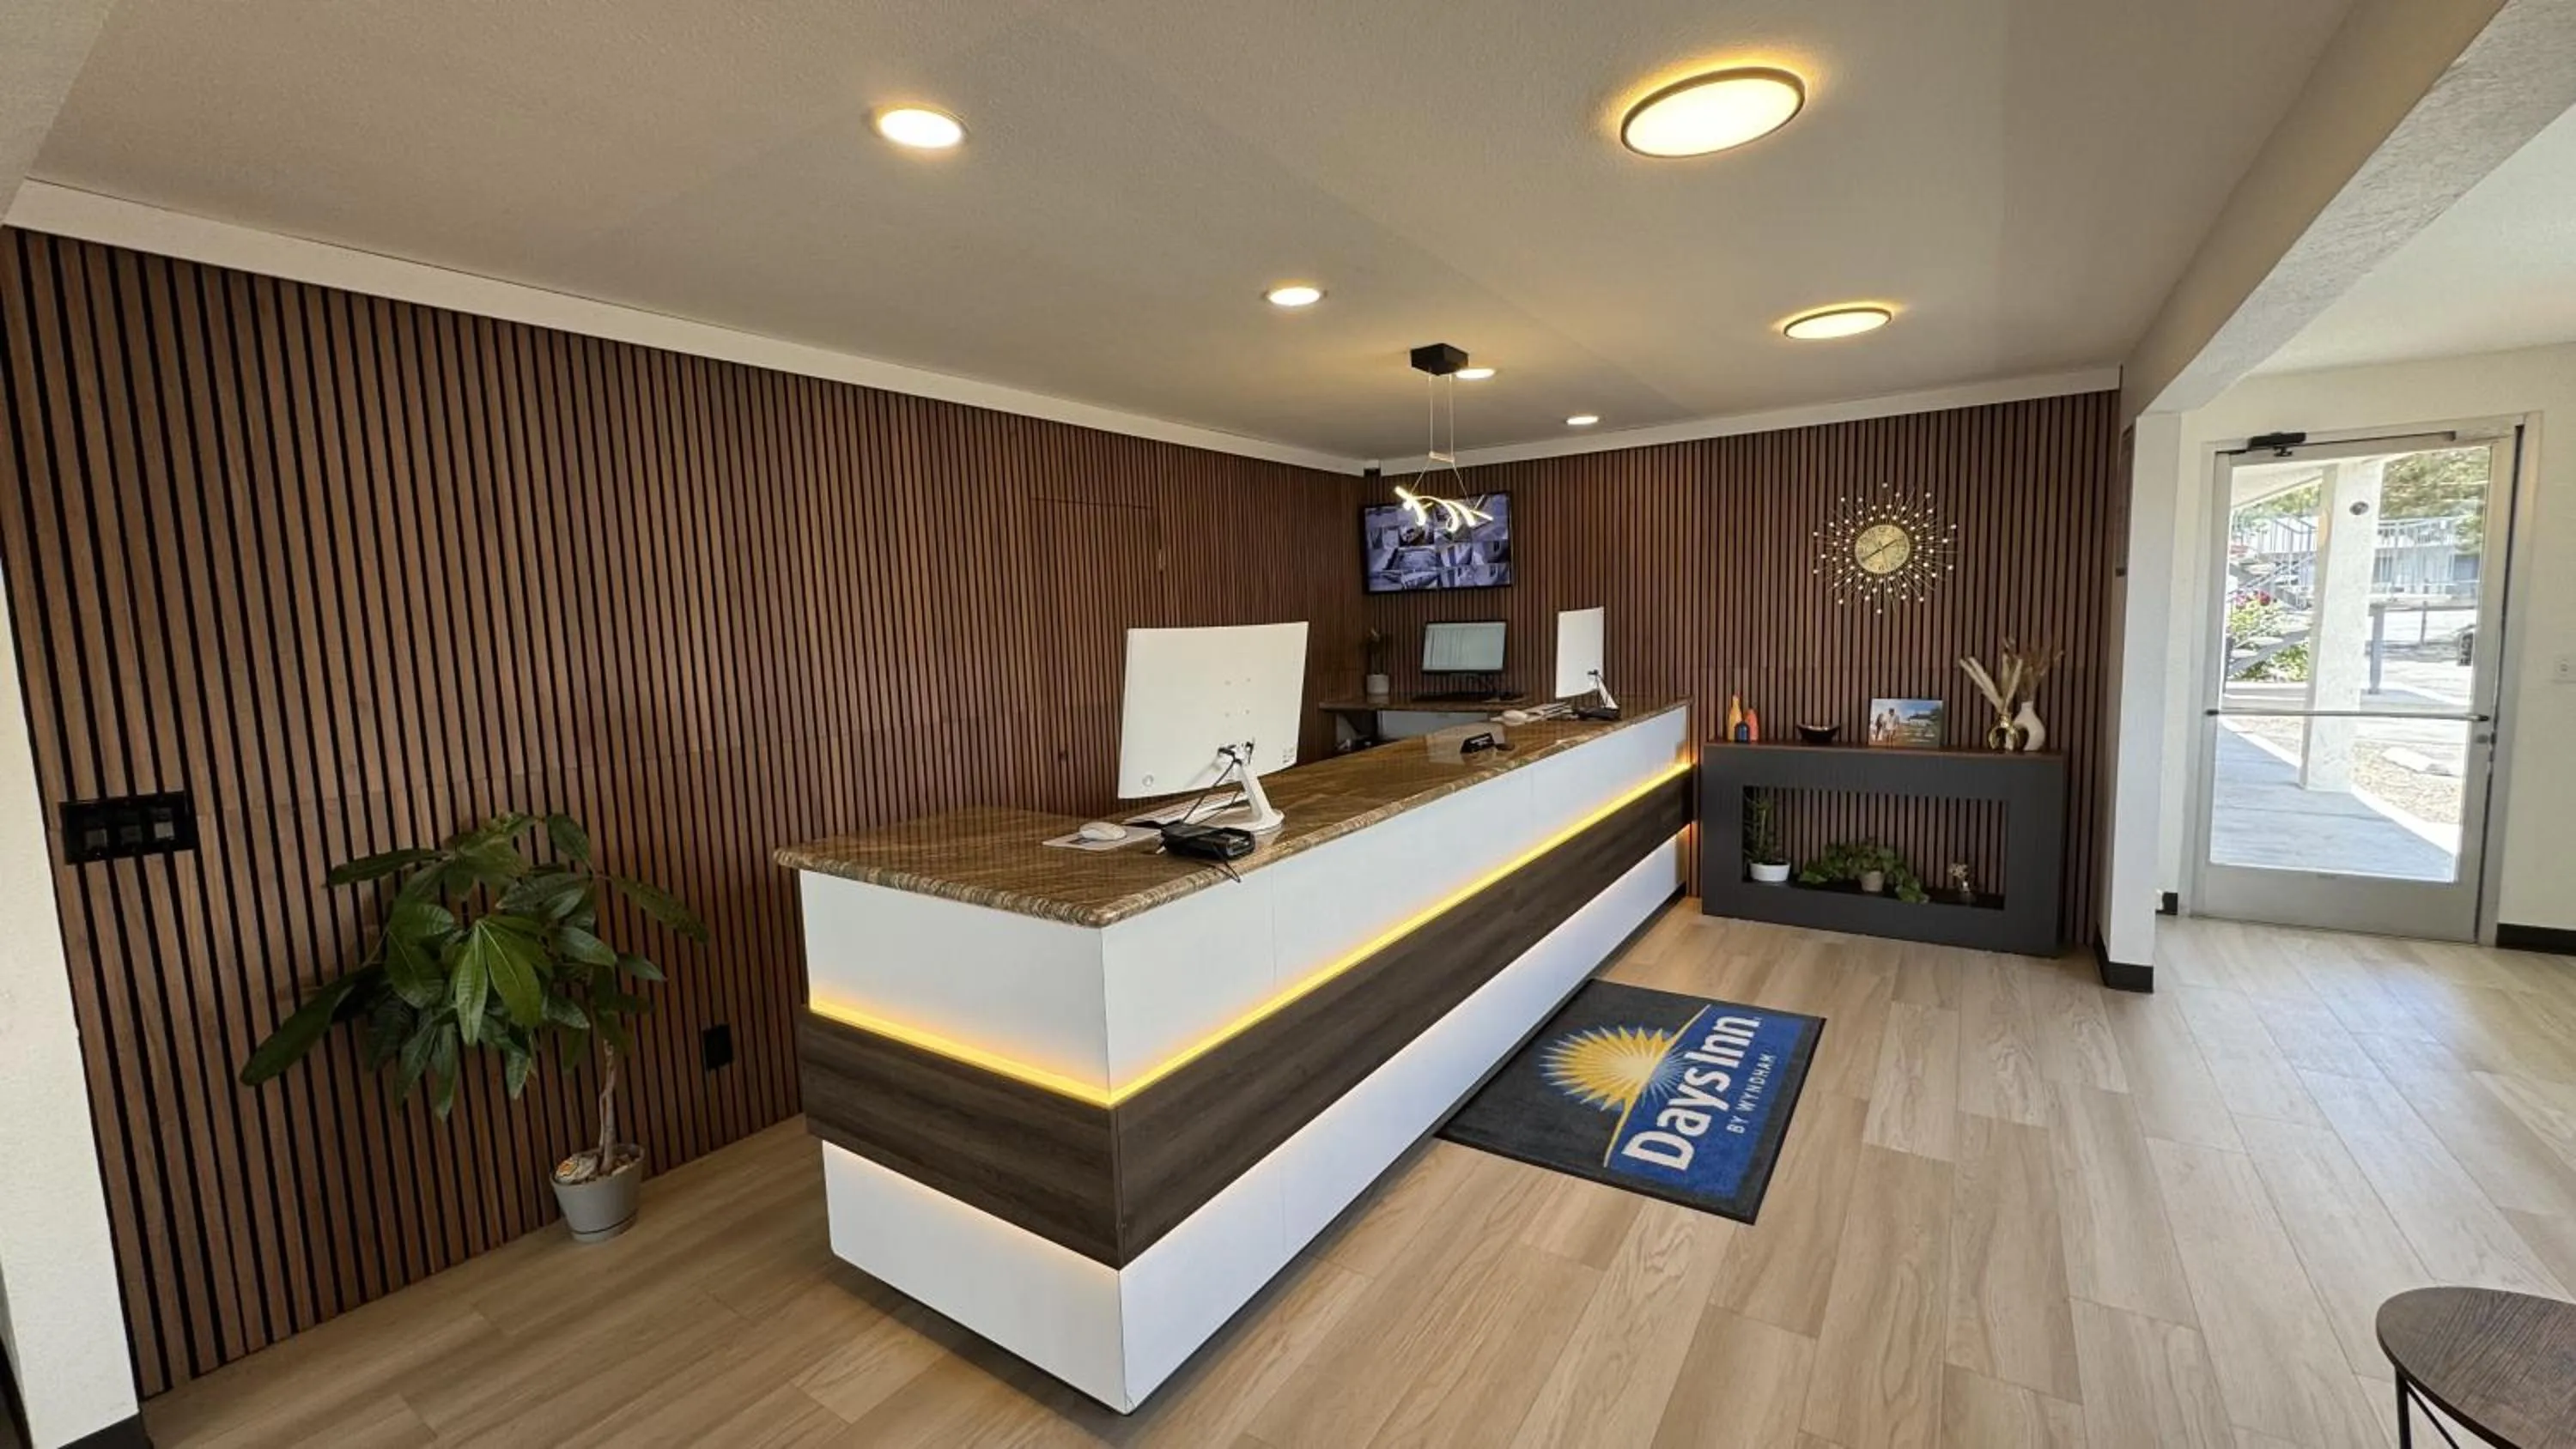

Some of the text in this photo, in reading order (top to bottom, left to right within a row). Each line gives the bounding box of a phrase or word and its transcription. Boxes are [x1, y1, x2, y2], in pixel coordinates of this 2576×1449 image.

[1621, 1016, 1760, 1171] Days Inn
[1726, 1053, 1777, 1134] BY WYNDHAM
